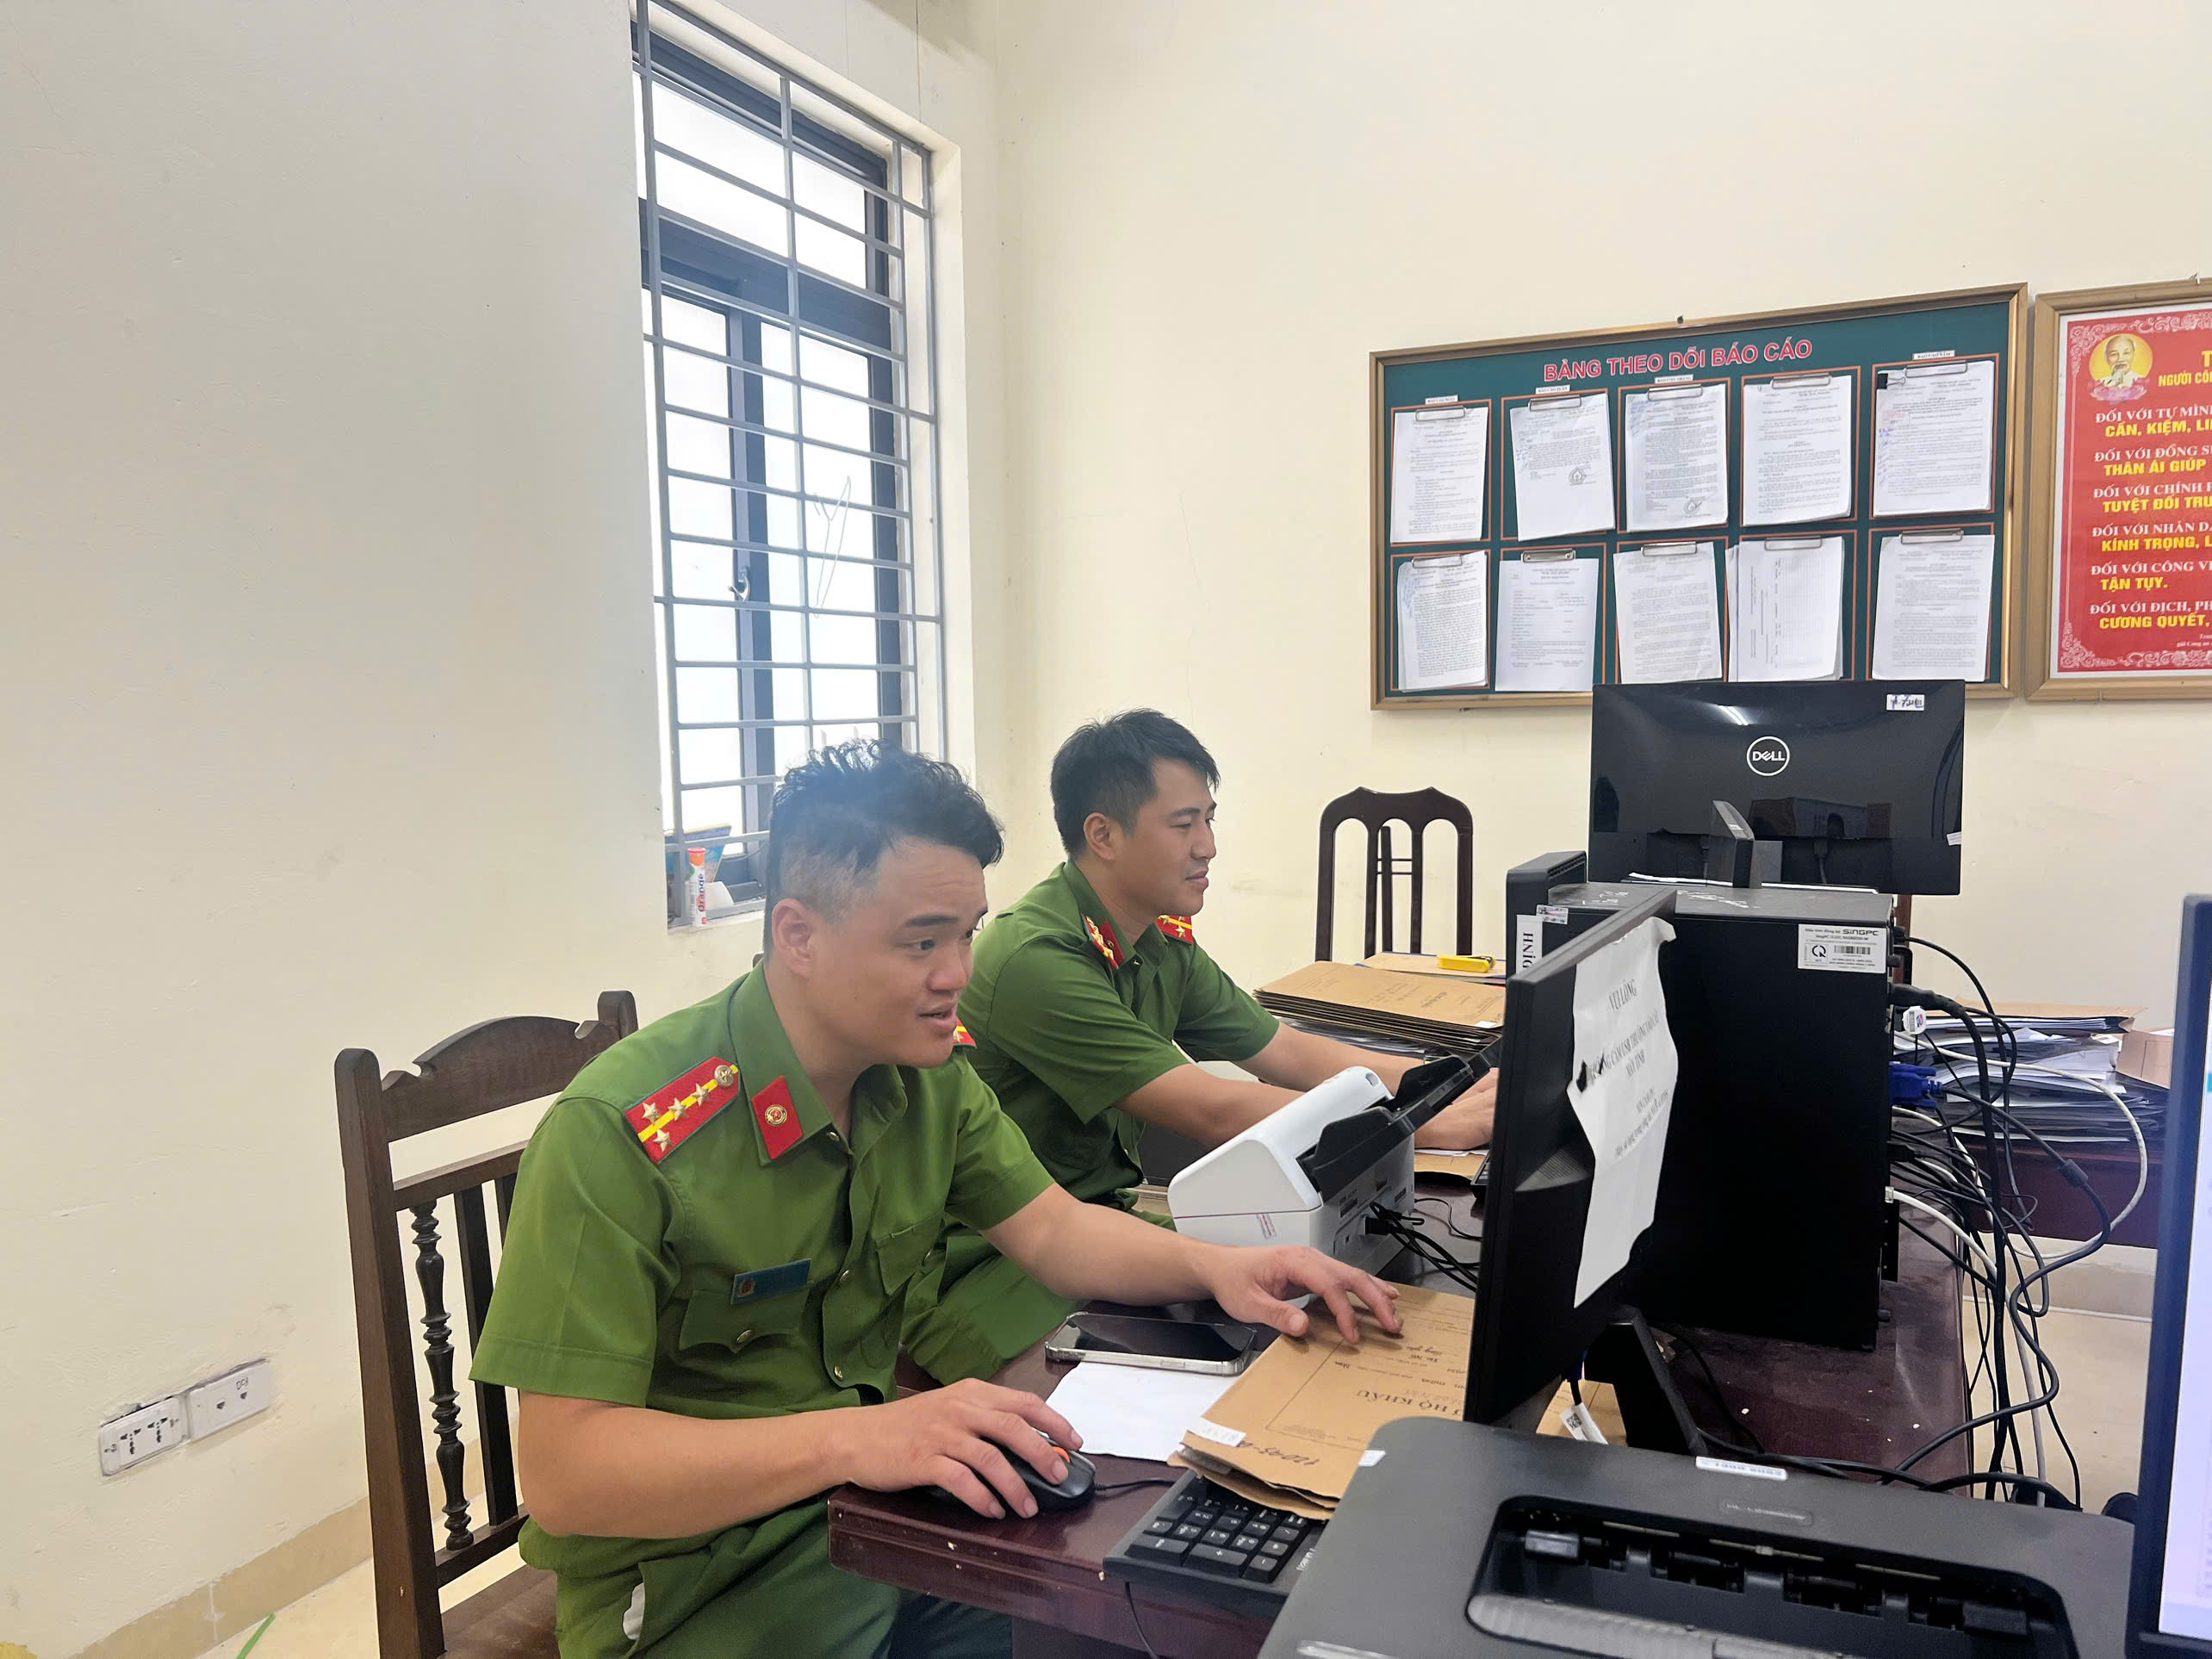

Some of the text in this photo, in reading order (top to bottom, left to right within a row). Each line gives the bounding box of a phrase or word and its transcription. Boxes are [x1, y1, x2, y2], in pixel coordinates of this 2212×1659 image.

[1544, 337, 1812, 382] BẢNG THEO DÕI BÁO CÁO
[2096, 407, 2122, 423] ĐỐI
[2127, 407, 2153, 420] VỚI
[2095, 448, 2121, 462] ĐỐI
[2125, 446, 2151, 460] VỚI
[2103, 457, 2206, 476] THÂN ÁI GIÚP
[2094, 483, 2119, 499] ĐỐI
[2124, 483, 2150, 496] VỚI
[2153, 481, 2203, 494] CHÍNH
[2103, 497, 2149, 513] TUYỆT
[2153, 494, 2179, 511] ĐỐI
[2092, 523, 2119, 537] ĐỐI
[2123, 523, 2149, 535] VỚI
[2153, 520, 2195, 534] NHÂN
[2102, 537, 2140, 551] KÍNH
[2091, 562, 2117, 575] ĐỐI
[2122, 562, 2147, 574] VỚI
[2152, 560, 2194, 572] CÔNG
[2101, 576, 2131, 593] TẬN
[2090, 600, 2116, 614] ĐỐI
[2121, 600, 2147, 612] VỚI
[2099, 616, 2153, 630] CƯƠNG
[1752, 750, 1786, 761] DELL
